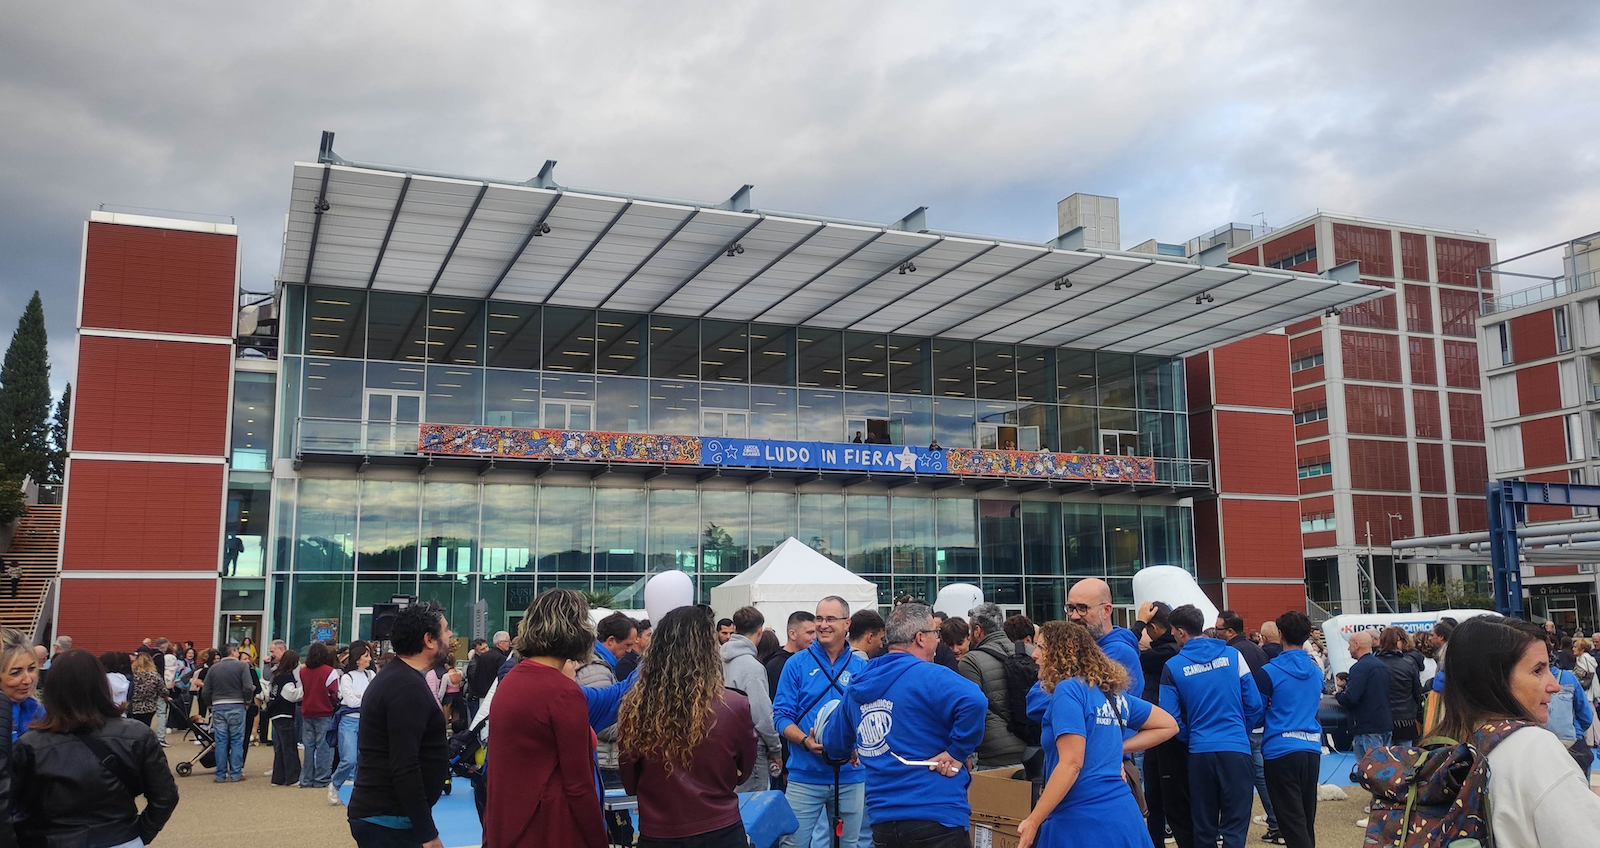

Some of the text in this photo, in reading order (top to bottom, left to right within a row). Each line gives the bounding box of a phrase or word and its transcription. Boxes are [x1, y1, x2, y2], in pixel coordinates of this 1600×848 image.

[765, 445, 810, 462] LUDO
[821, 448, 837, 465] IN
[844, 448, 895, 467] FIERA
[1393, 622, 1437, 633] ECATHLON
[1183, 656, 1230, 677] SCANDICCI RUGBY
[859, 699, 894, 713] SCANDICCI
